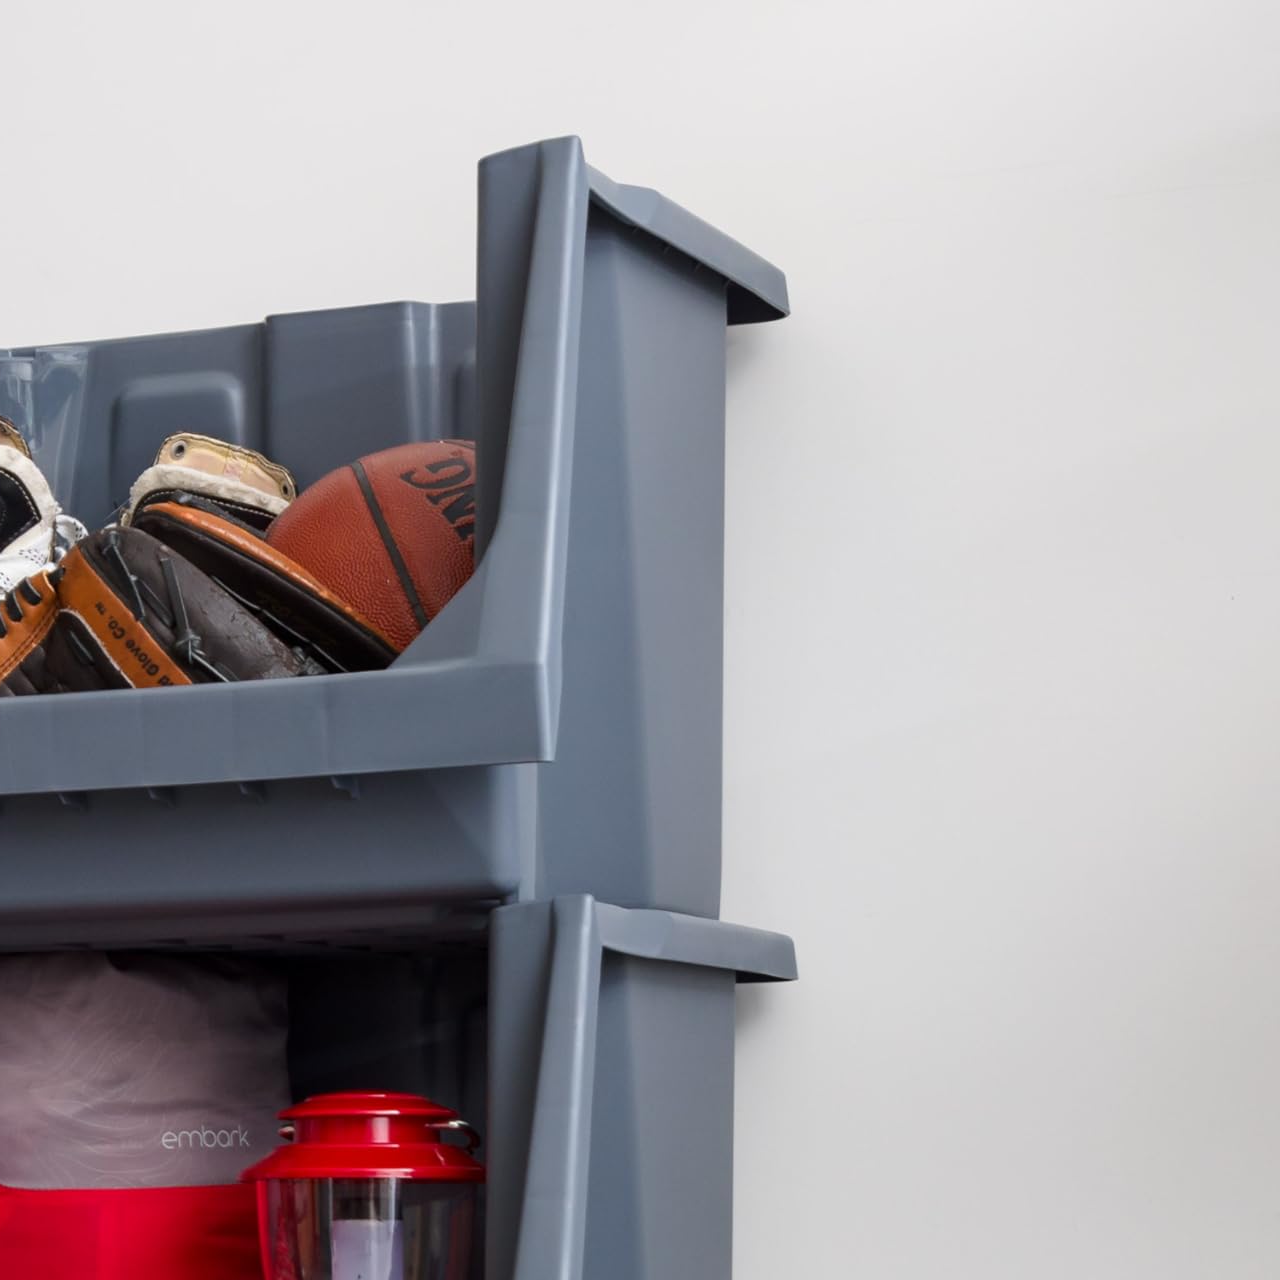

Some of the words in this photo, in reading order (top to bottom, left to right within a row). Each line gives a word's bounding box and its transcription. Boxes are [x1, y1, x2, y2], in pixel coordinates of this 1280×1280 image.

[108, 616, 126, 639] Co.
[126, 639, 160, 676] Glove
[161, 1124, 250, 1149] embark
